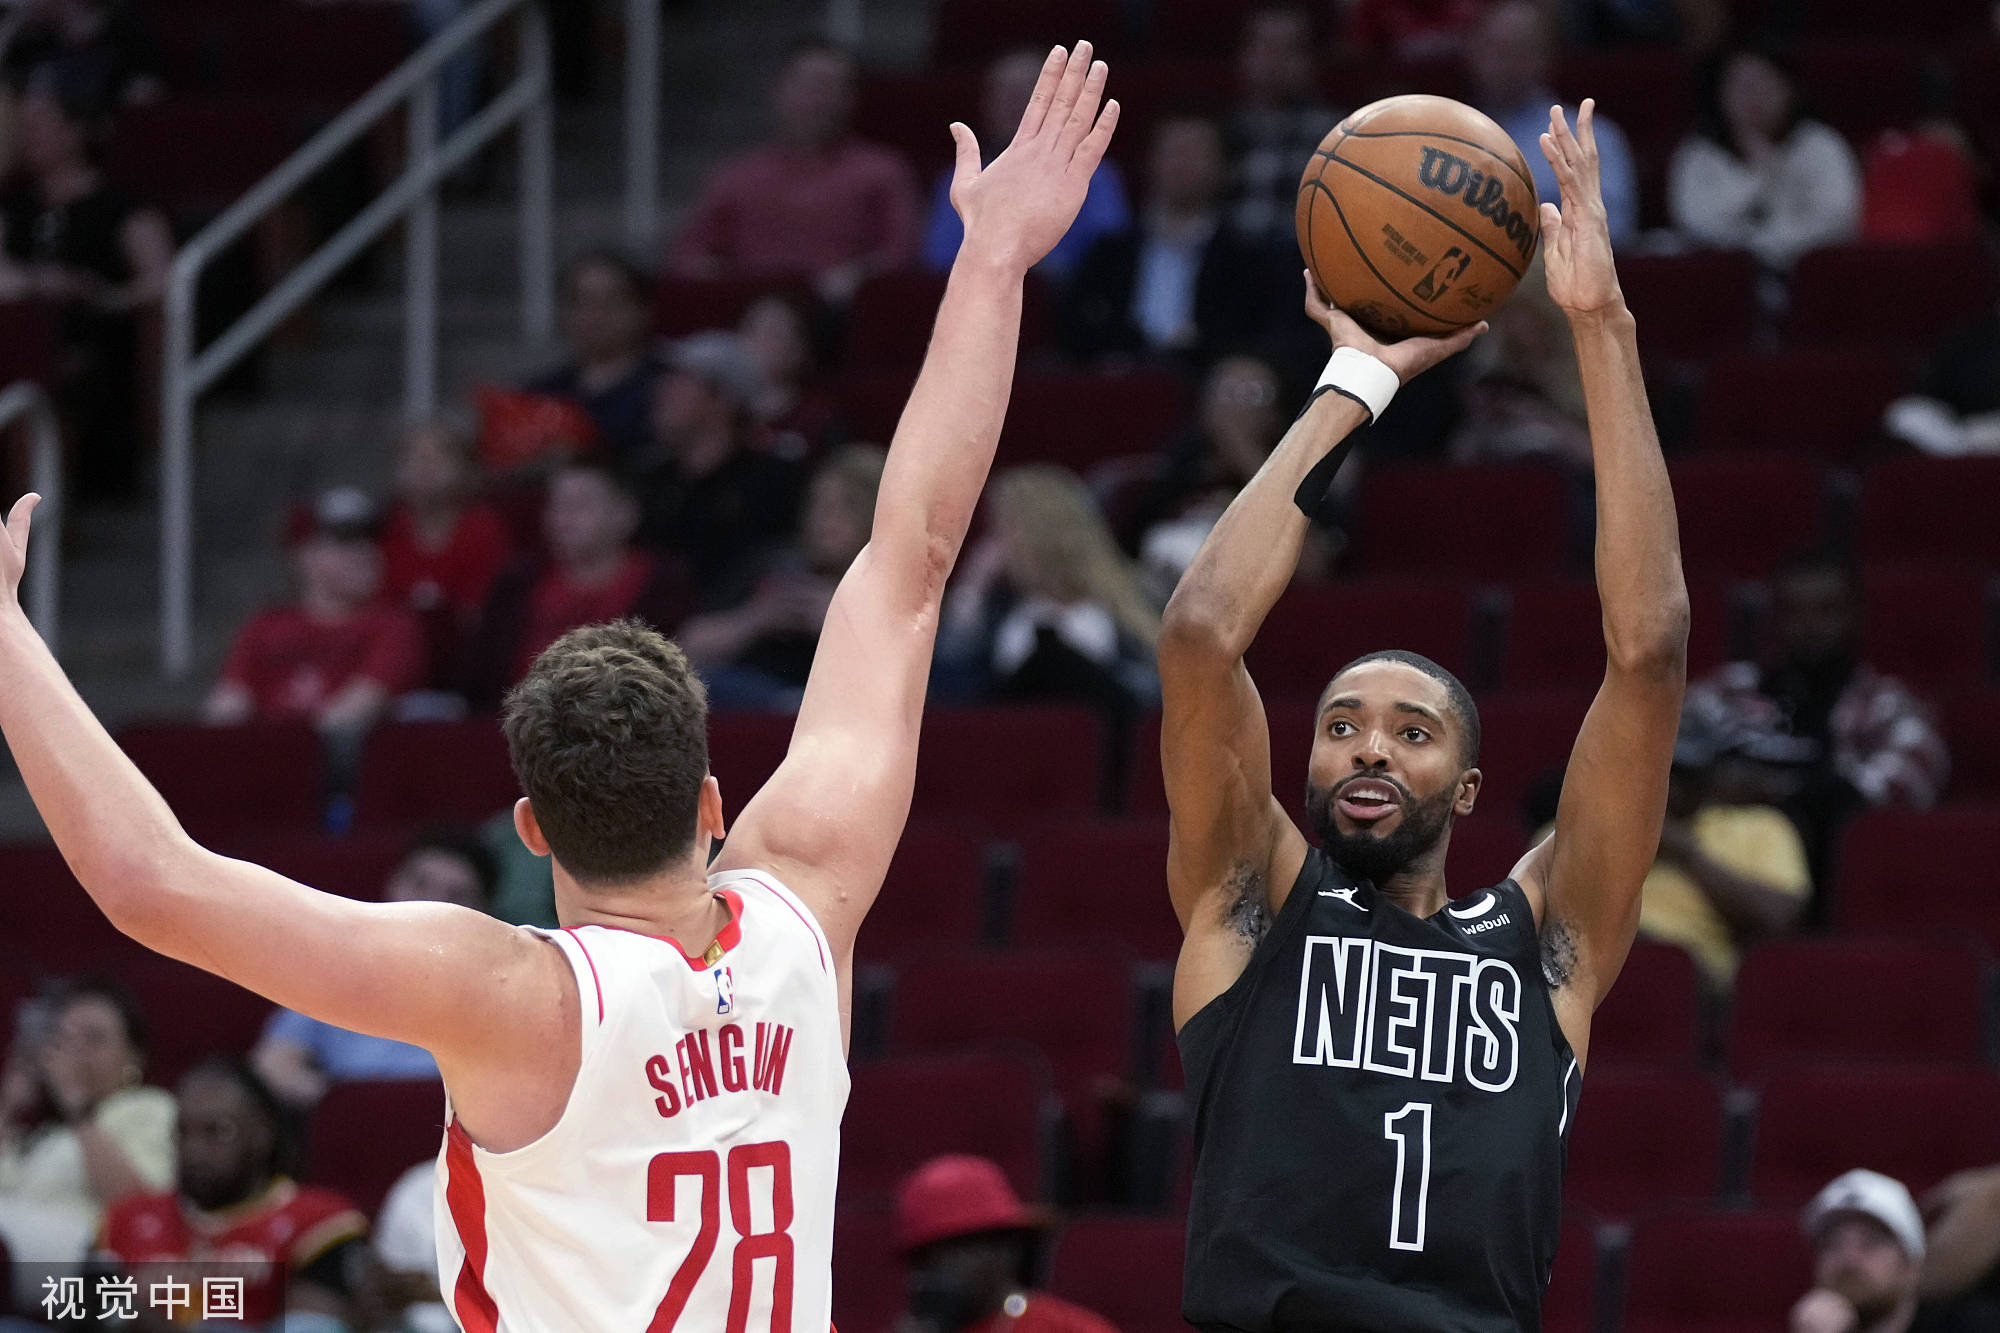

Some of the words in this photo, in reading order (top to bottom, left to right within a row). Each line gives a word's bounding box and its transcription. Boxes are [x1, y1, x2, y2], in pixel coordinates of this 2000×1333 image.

[1418, 145, 1534, 260] Wilson
[1461, 913, 1511, 935] Webull
[645, 1022, 794, 1118] SENGUN
[1293, 936, 1522, 1093] NETS
[646, 1140, 794, 1333] 28
[1384, 1102, 1433, 1252] 1
